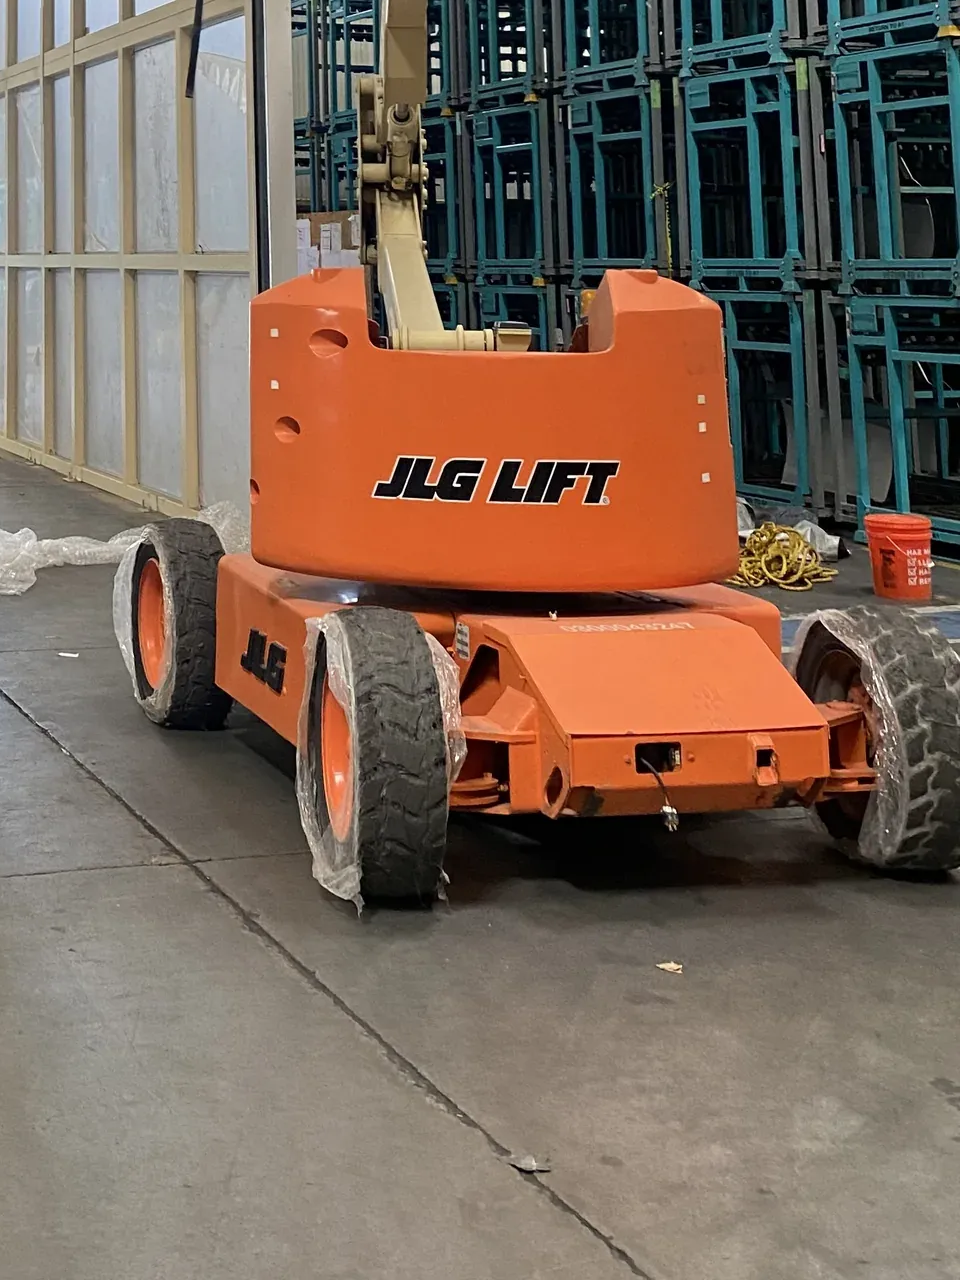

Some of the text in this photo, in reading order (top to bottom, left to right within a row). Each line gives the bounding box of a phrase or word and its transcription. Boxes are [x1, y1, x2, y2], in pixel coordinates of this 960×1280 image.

[371, 455, 620, 505] JLG LIFT
[240, 627, 288, 697] JLG
